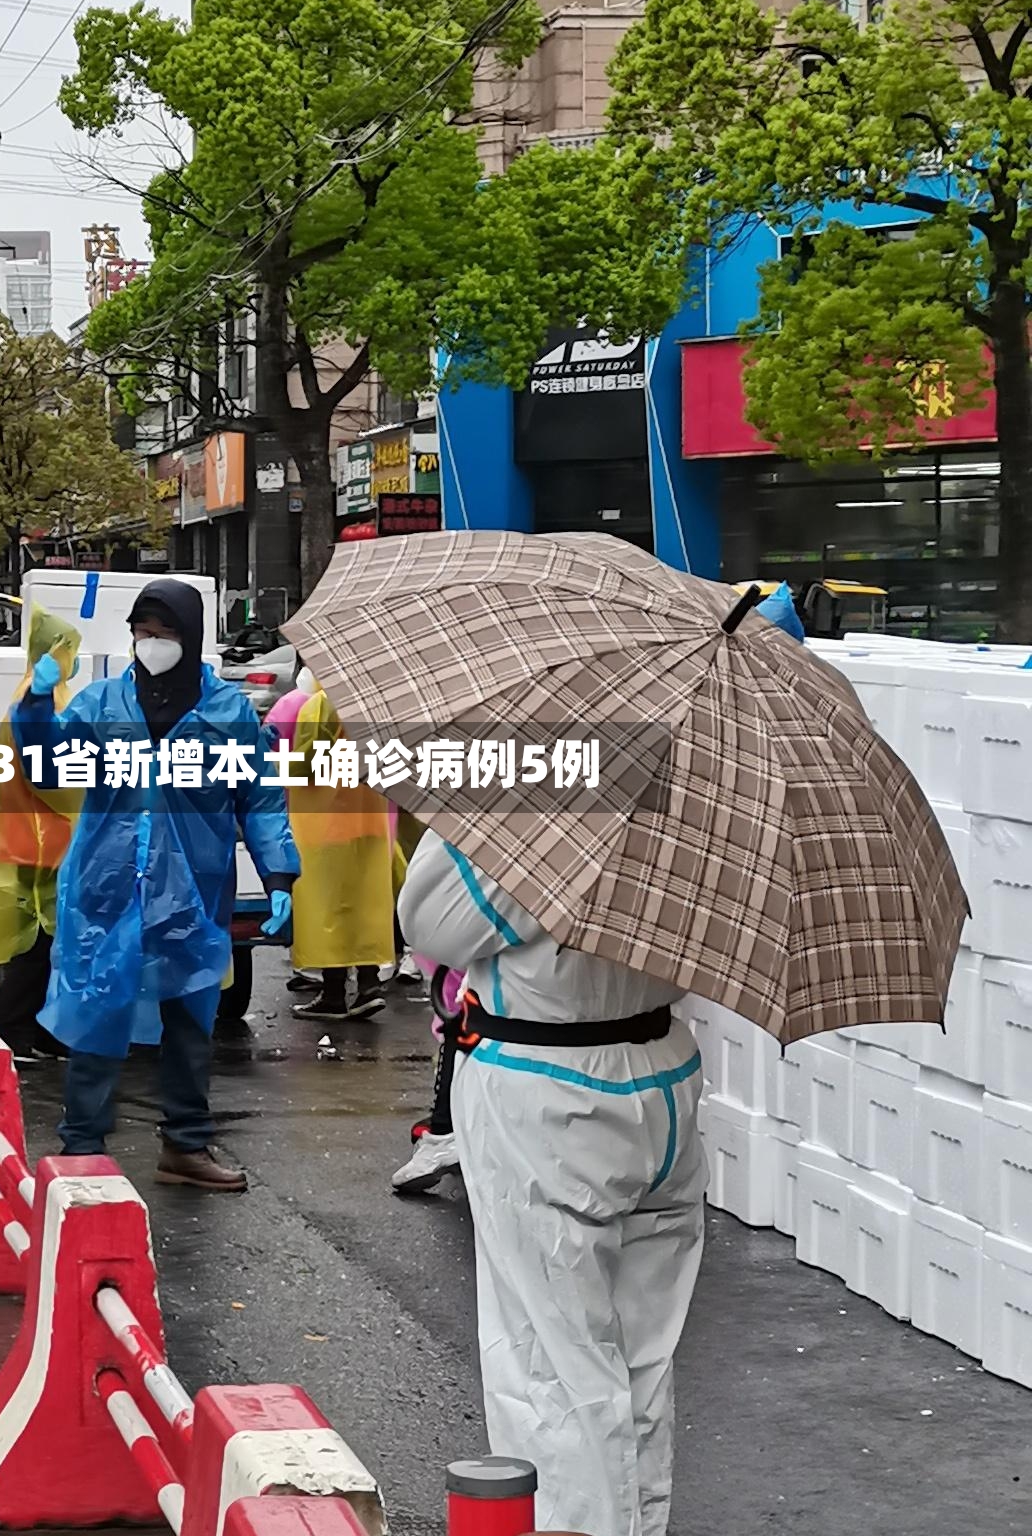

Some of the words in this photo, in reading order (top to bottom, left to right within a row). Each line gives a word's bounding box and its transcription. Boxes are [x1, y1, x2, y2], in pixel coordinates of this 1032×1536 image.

[532, 365, 572, 374] POWER
[575, 361, 635, 373] SATURDAY
[530, 373, 644, 394] PS连锁健身概念店
